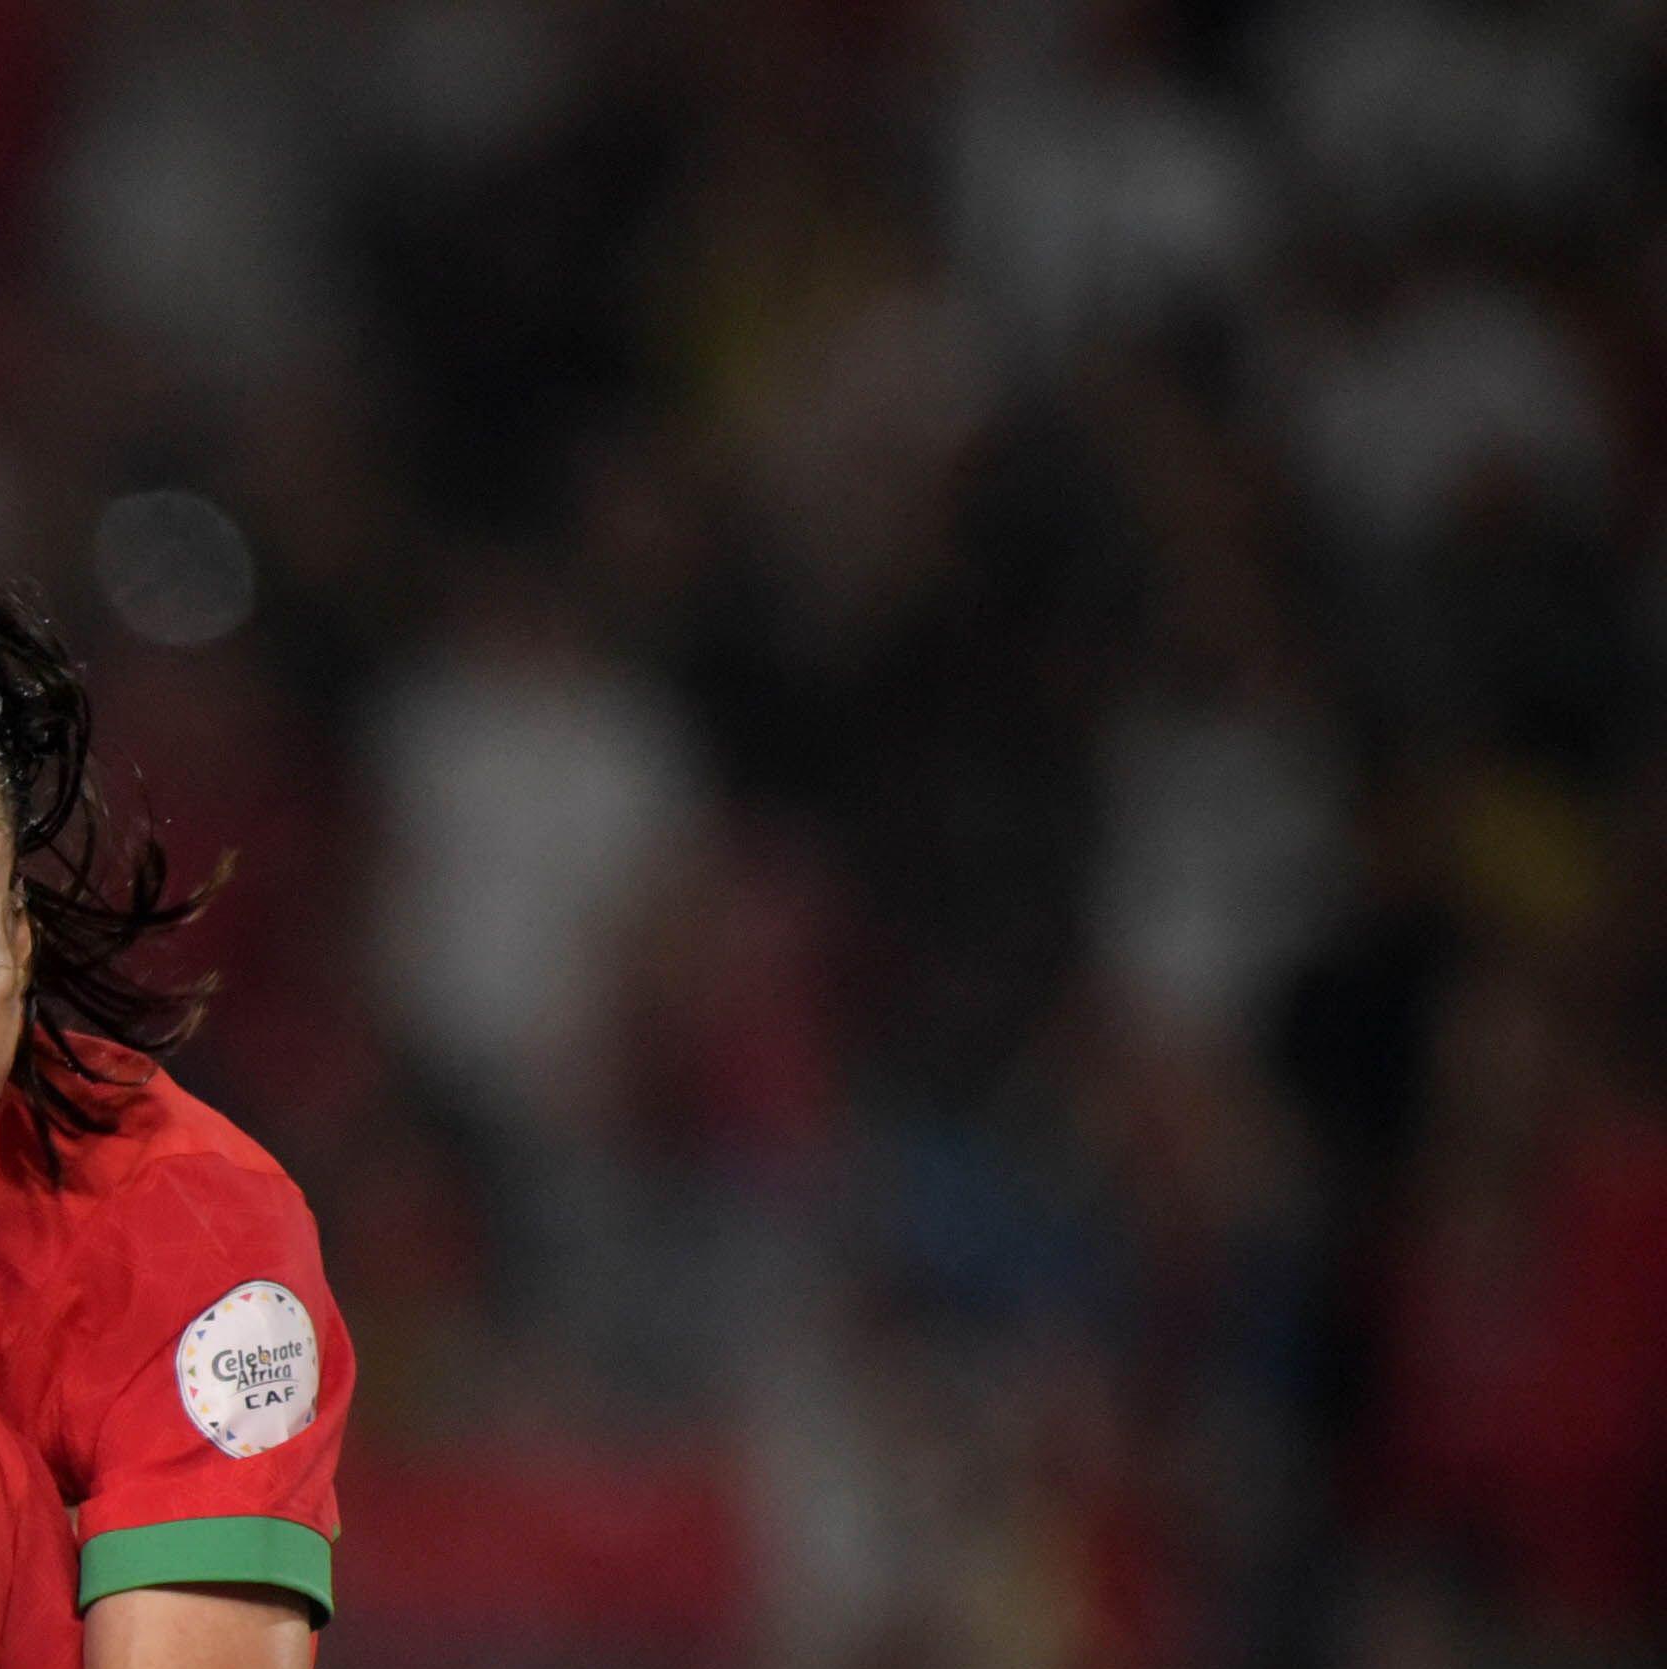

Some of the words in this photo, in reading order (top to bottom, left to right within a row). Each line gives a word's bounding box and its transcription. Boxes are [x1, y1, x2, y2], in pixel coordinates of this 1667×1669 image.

[212, 1341, 303, 1381] Celebrate
[237, 1363, 292, 1390] Africa
[245, 1386, 296, 1410] CAF
